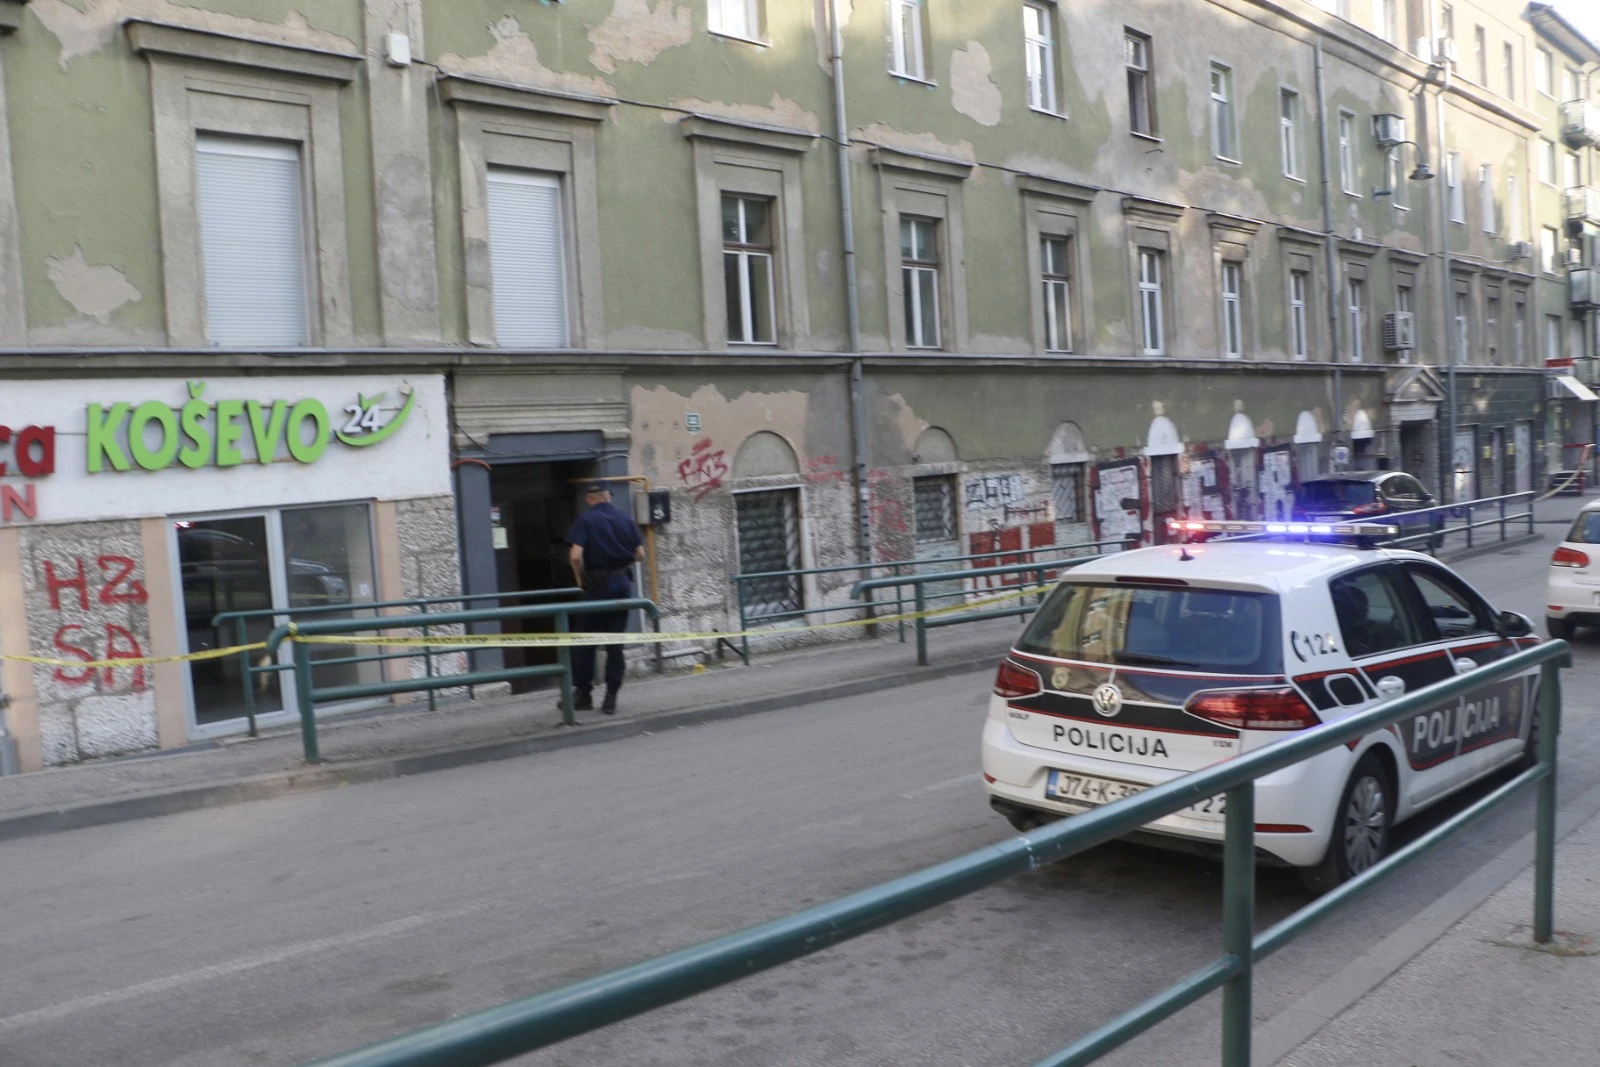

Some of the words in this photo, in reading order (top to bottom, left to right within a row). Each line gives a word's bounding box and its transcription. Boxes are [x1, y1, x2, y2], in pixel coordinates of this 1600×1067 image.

[87, 380, 330, 474] KOŠEVO
[343, 404, 383, 433] 24
[53, 622, 146, 692] SA
[1304, 633, 1339, 656] 122
[1053, 724, 1169, 758] POLICIJA
[1412, 696, 1500, 754] POLICIJA
